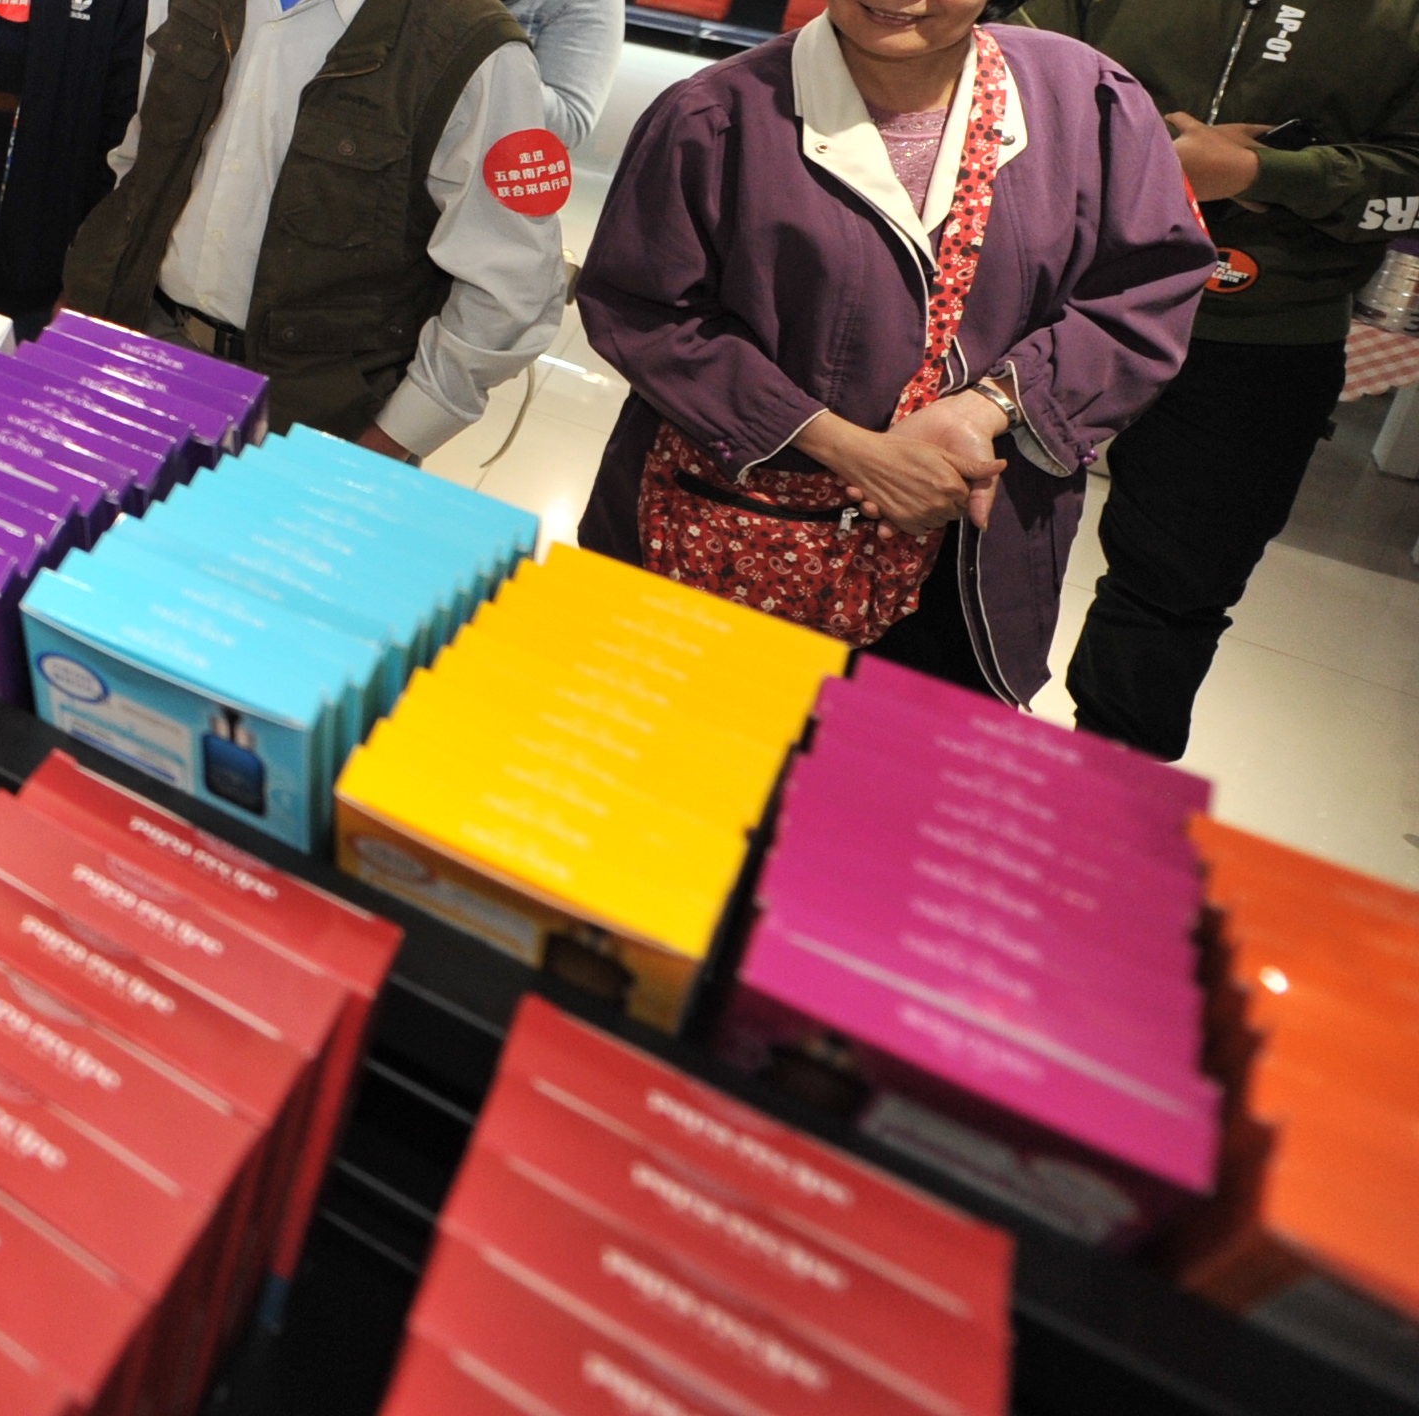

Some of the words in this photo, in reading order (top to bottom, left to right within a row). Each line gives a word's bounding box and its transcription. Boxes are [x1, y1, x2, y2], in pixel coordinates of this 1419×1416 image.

[1262, 4, 1306, 63] AP-01
[519, 150, 544, 164] 走进
[494, 160, 566, 182] 五象南产业园
[497, 177, 569, 197] 联合采风行动
